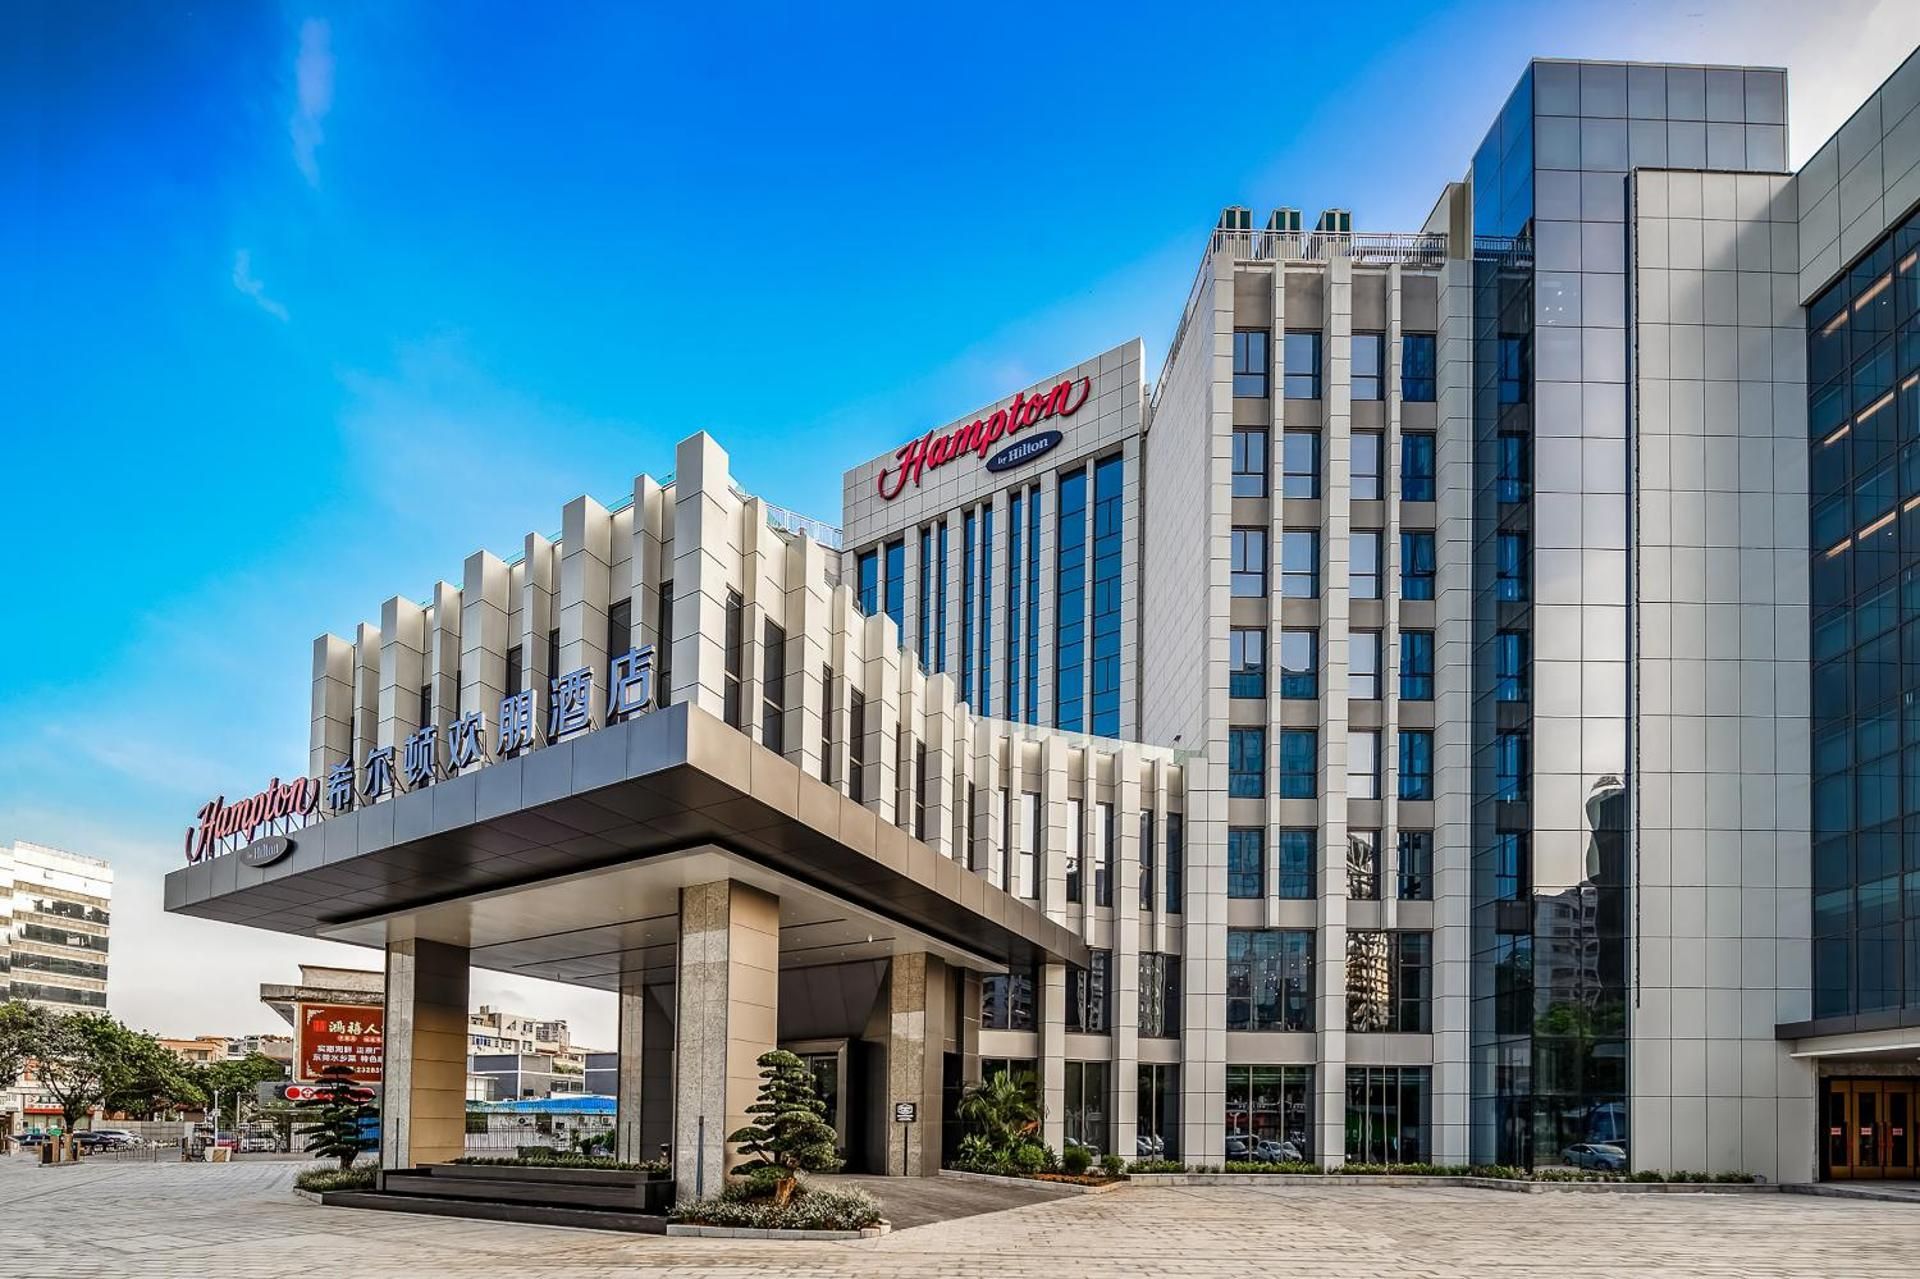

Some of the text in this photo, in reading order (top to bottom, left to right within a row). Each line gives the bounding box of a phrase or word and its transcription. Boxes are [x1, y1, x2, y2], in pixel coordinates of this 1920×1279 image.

[878, 376, 1090, 500] Hampton
[998, 438, 1048, 465] by Hilton
[327, 644, 656, 812] 希尔顿欢朋酒店
[185, 776, 320, 862] Hampton
[328, 1020, 383, 1034] 鸿禧人
